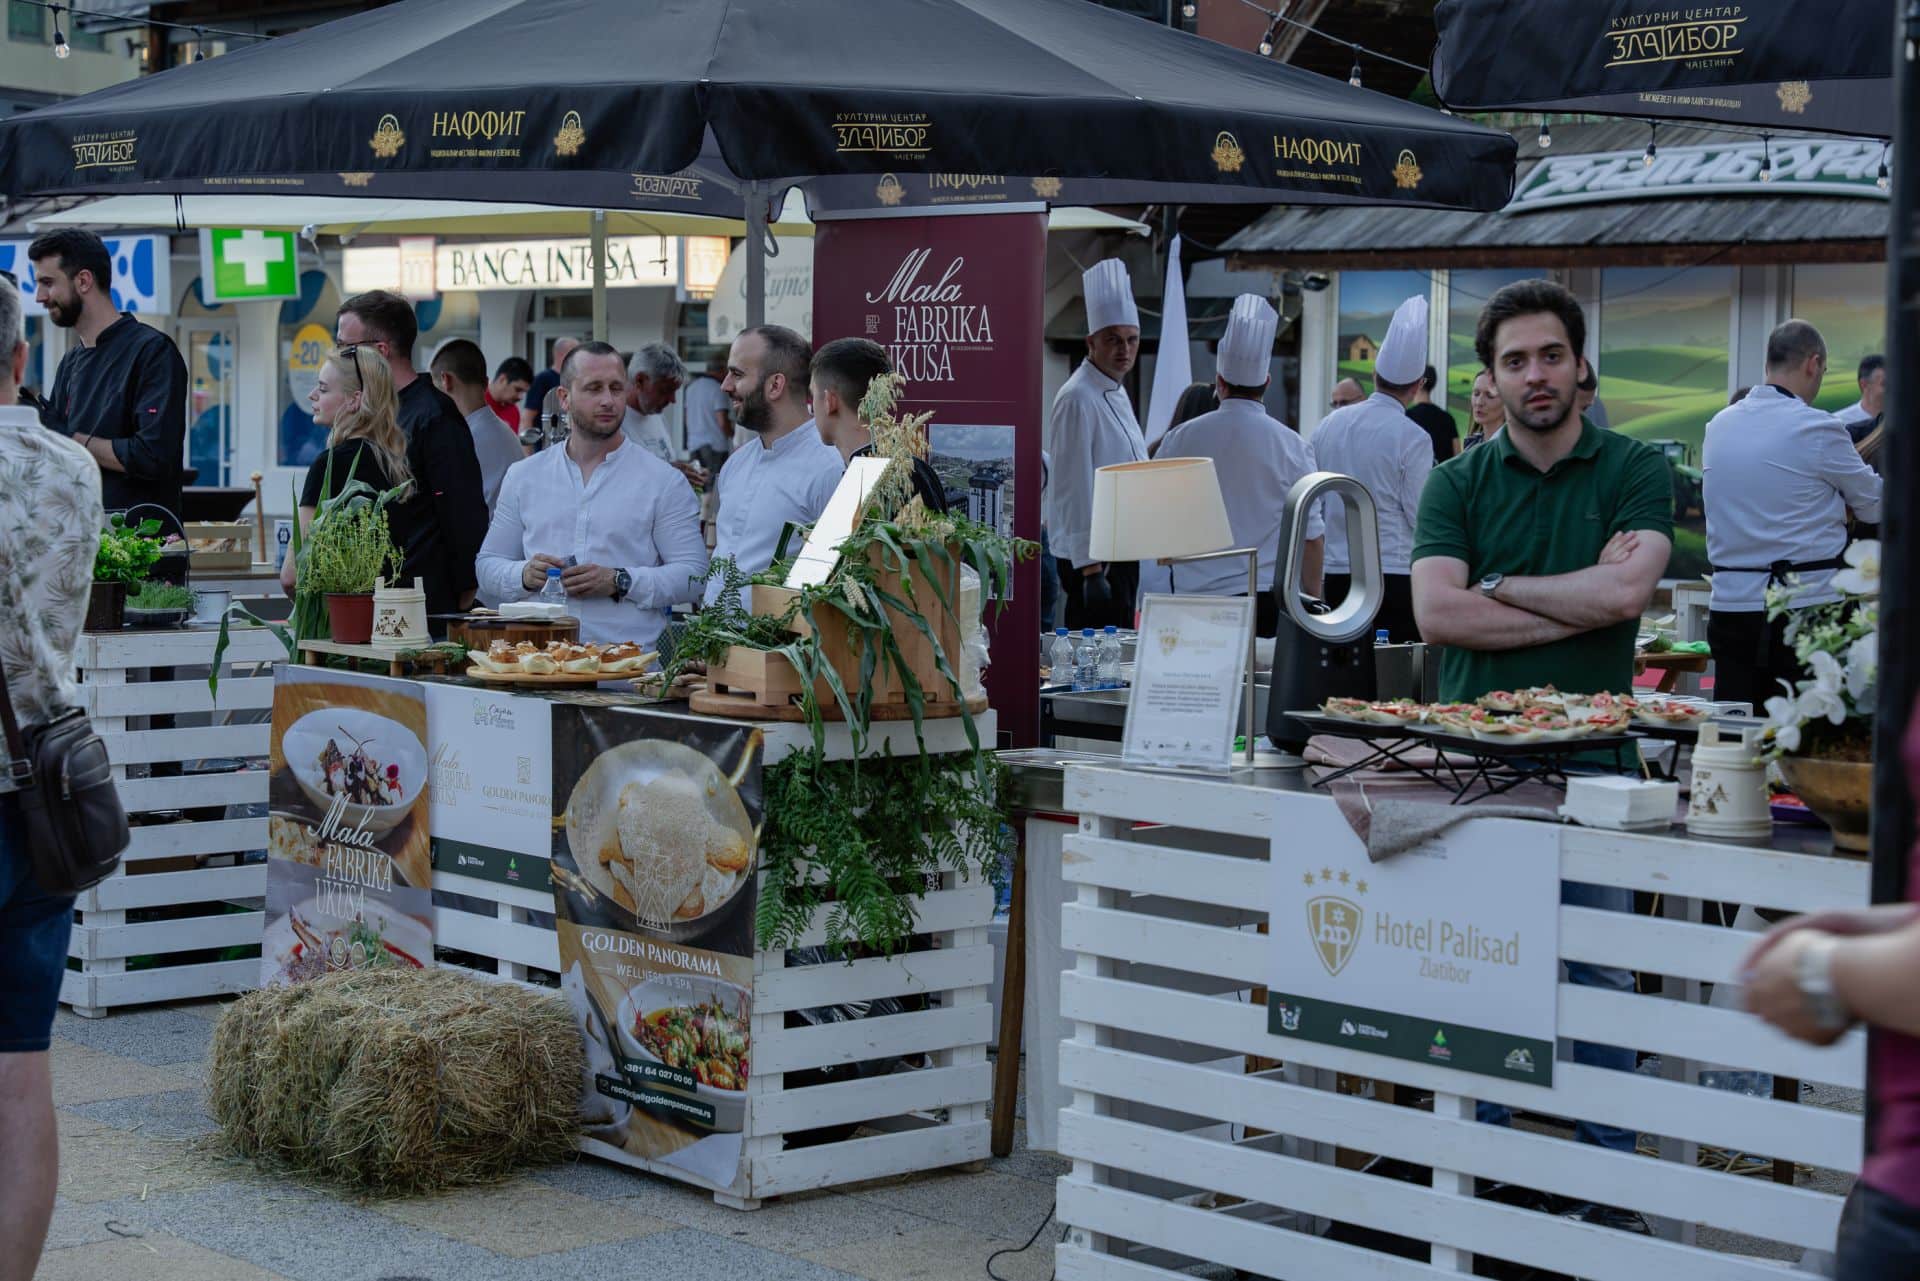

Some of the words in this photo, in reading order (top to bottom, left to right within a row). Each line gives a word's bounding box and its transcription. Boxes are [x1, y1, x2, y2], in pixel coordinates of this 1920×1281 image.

[1611, 11, 1679, 28] КУЛТУРНИ
[1685, 6, 1742, 20] ЦЕНТАР
[1609, 20, 1742, 63] ЗЛАТИБОР
[432, 111, 526, 140] НАФФИТ
[837, 112, 887, 122] КУЛТУРНИ
[891, 113, 928, 122] ЦЕНТАР
[73, 140, 135, 166] ЗЛАТИБОР
[834, 125, 930, 150] ЗЛАТИБОР
[1273, 135, 1361, 166] НАФФИТ
[452, 248, 537, 285] BANCA
[546, 243, 639, 281] INTSA
[866, 248, 964, 303] Mala
[894, 304, 993, 342] FABRIKA
[307, 790, 376, 848] Mala
[326, 843, 393, 893] FABRIKA
[315, 878, 365, 924] UKUSA
[582, 932, 645, 959] GOLDEN
[647, 943, 722, 976] PANORAMA
[1375, 911, 1432, 953] Hotel
[1441, 920, 1520, 967] Palisad
[1419, 956, 1473, 984] Zlatibor
